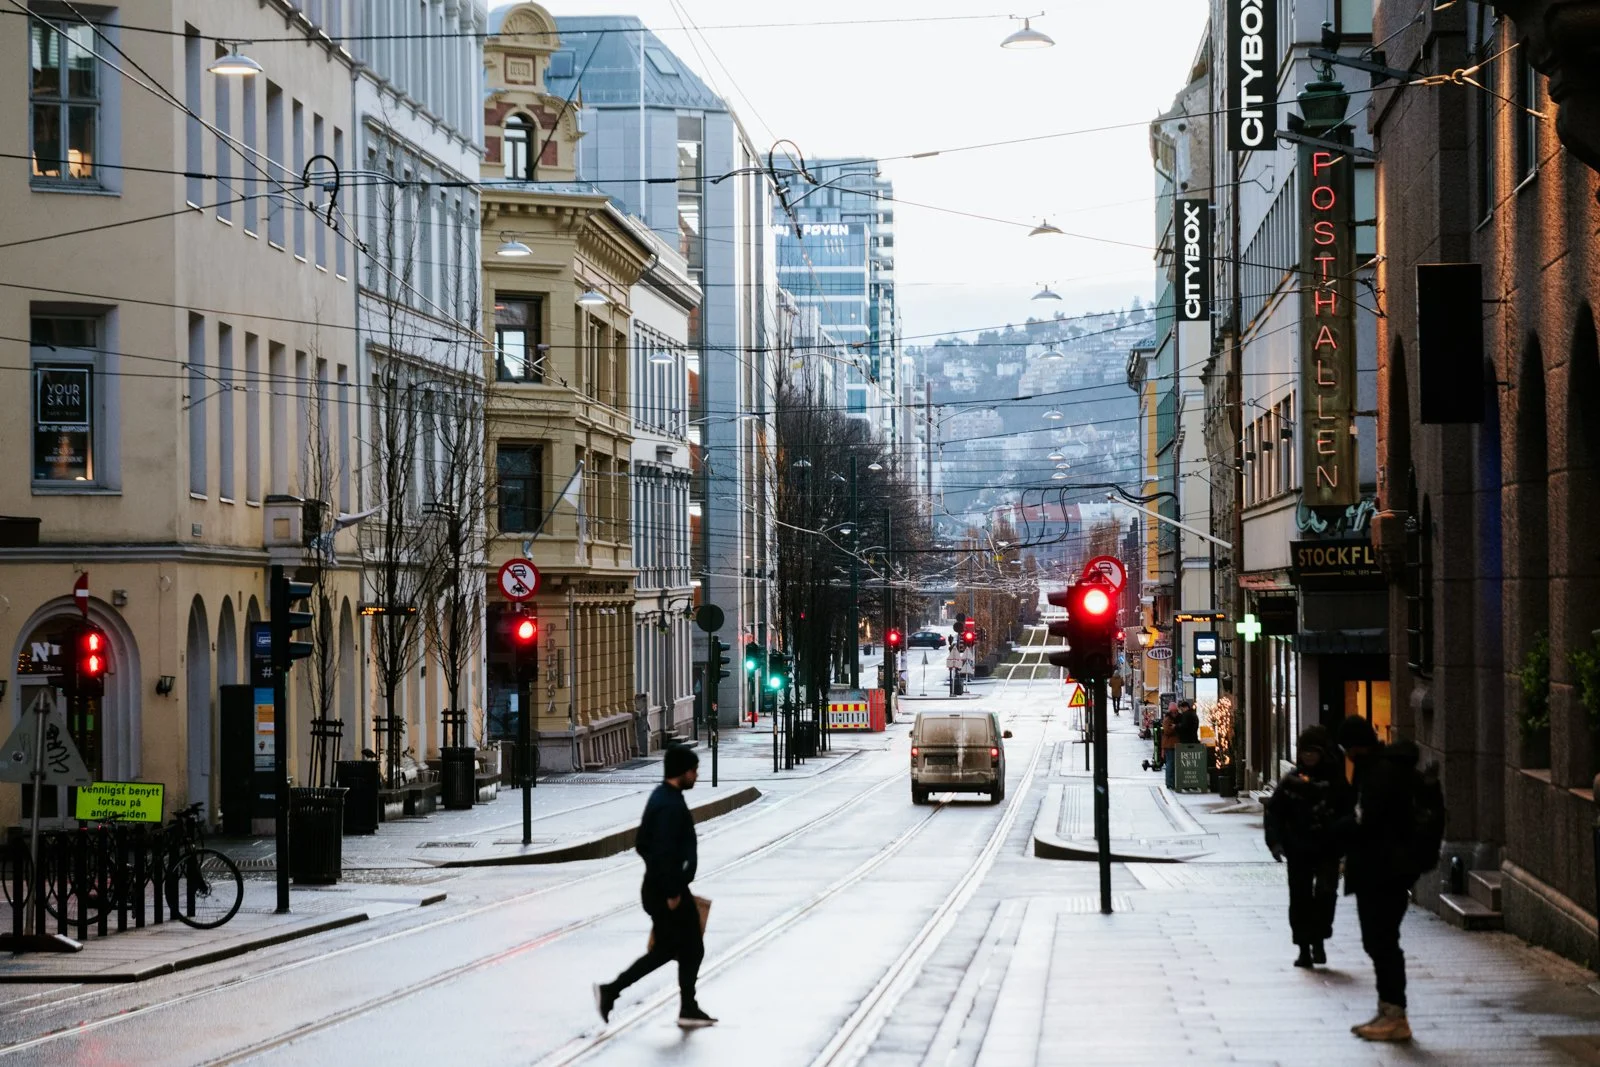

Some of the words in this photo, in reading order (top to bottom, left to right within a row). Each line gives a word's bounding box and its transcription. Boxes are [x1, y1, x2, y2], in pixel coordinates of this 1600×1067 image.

[1311, 151, 1338, 488] POSTHALLEN
[47, 384, 80, 395] YOUR
[47, 395, 80, 407] SKIN
[128, 786, 160, 798] benytt
[97, 796, 126, 807] fortau
[129, 798, 141, 809] på
[90, 806, 117, 818] andre
[121, 808, 147, 819] siden
